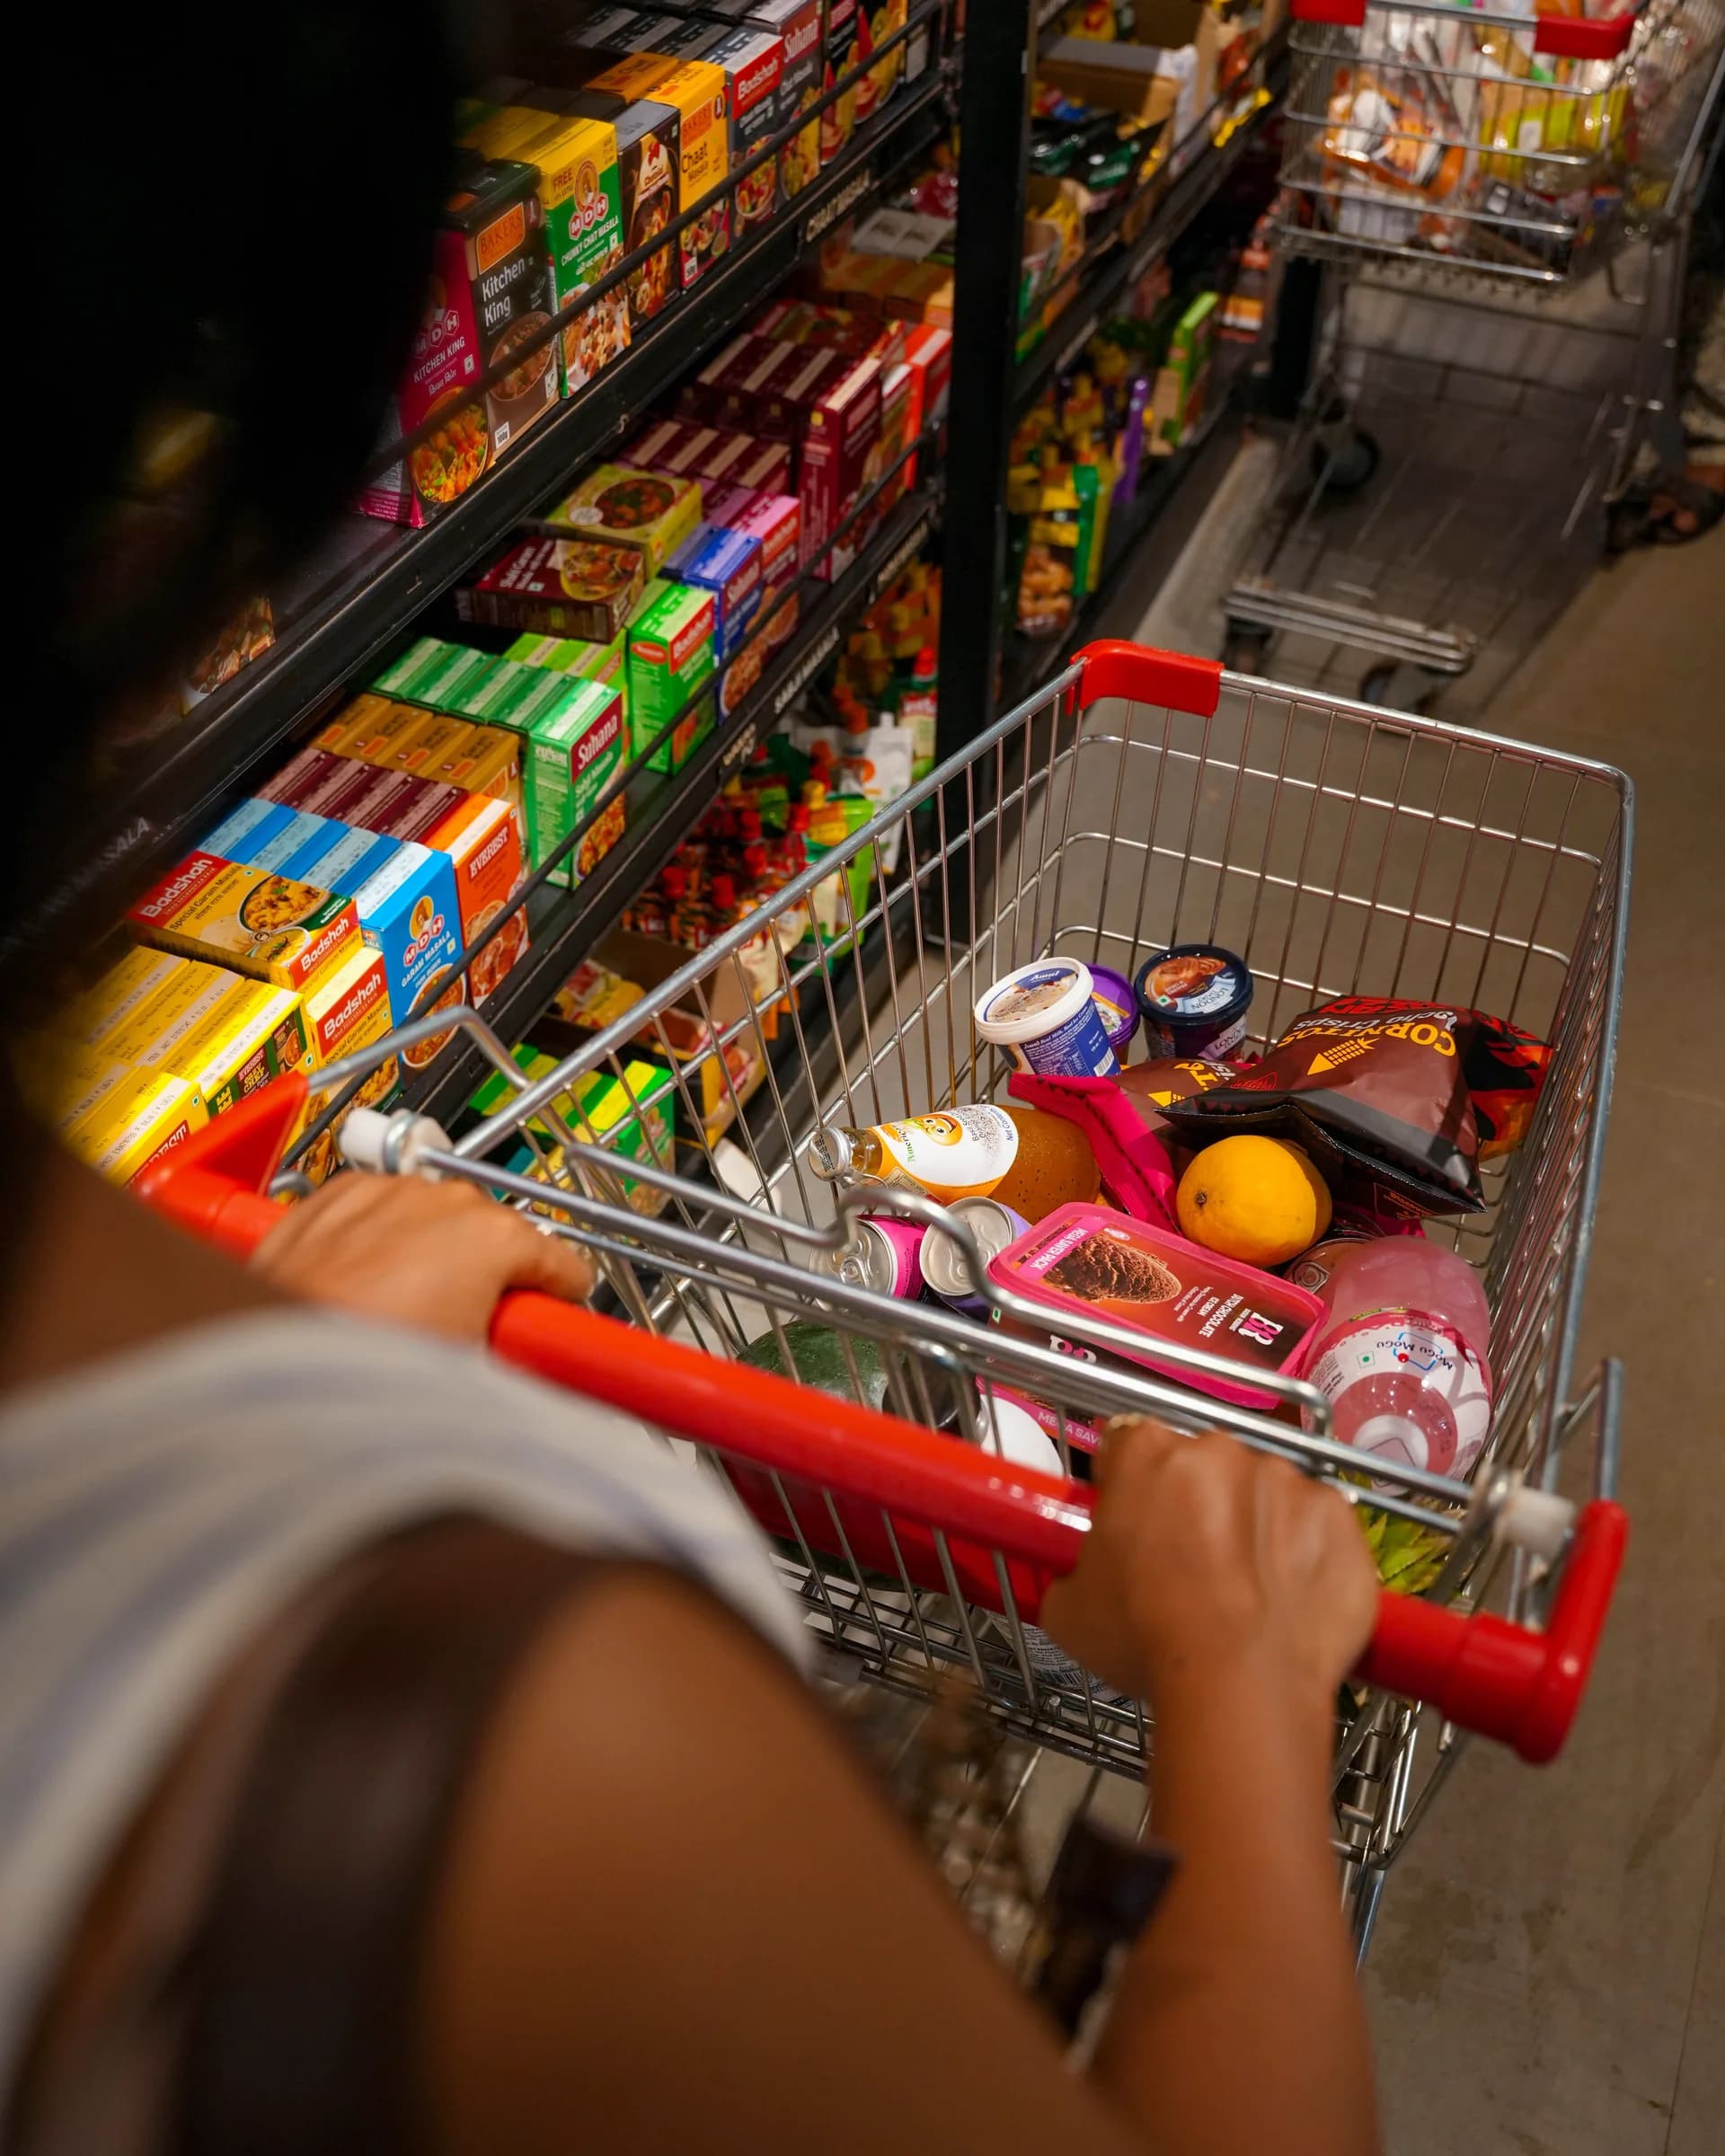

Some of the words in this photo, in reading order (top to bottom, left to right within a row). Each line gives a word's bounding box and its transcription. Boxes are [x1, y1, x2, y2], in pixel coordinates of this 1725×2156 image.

[738, 57, 779, 102] Badshah
[681, 141, 708, 172] Chaat
[553, 167, 573, 191] FREE
[479, 210, 522, 255] BAKERS
[571, 195, 607, 236] MDH
[482, 257, 526, 303] Kitchen
[483, 295, 511, 327] King
[415, 314, 459, 355] MDH
[413, 353, 447, 384] KITCHEN
[447, 335, 465, 359] KING
[578, 714, 618, 770] Suhana
[469, 826, 509, 879] EVEREST
[139, 857, 214, 918] Badshah
[169, 902, 197, 932] Special
[194, 884, 220, 911] Garam
[216, 863, 243, 890] Masala
[300, 916, 349, 971] Badshah
[403, 916, 445, 966] MDH
[401, 954, 425, 988] GARAM
[422, 930, 452, 963] MASALA
[1030, 971, 1060, 982] Amul
[323, 972, 382, 1040] Badshah
[366, 998, 389, 1022] Masala
[1190, 986, 1228, 1011] LONDON
[1276, 1021, 1457, 1057] CORNITOS
[1293, 1016, 1382, 1032] Crisps
[1024, 1040, 1039, 1050] Amul
[1040, 1036, 1051, 1045] Real
[238, 1047, 265, 1082] EVEREST
[243, 1066, 266, 1093] CHEF
[1005, 1129, 1014, 1142] Net
[1051, 1236, 1074, 1259] SAVER
[1072, 1226, 1091, 1242] MEGA
[1031, 1250, 1053, 1271] PACK
[1225, 1293, 1244, 1310] DUTCH
[1198, 1303, 1234, 1339] CHOCOLATE
[1237, 1312, 1284, 1346] BR
[1038, 1411, 1074, 1435] MEA
[1074, 1429, 1101, 1446] SAV
